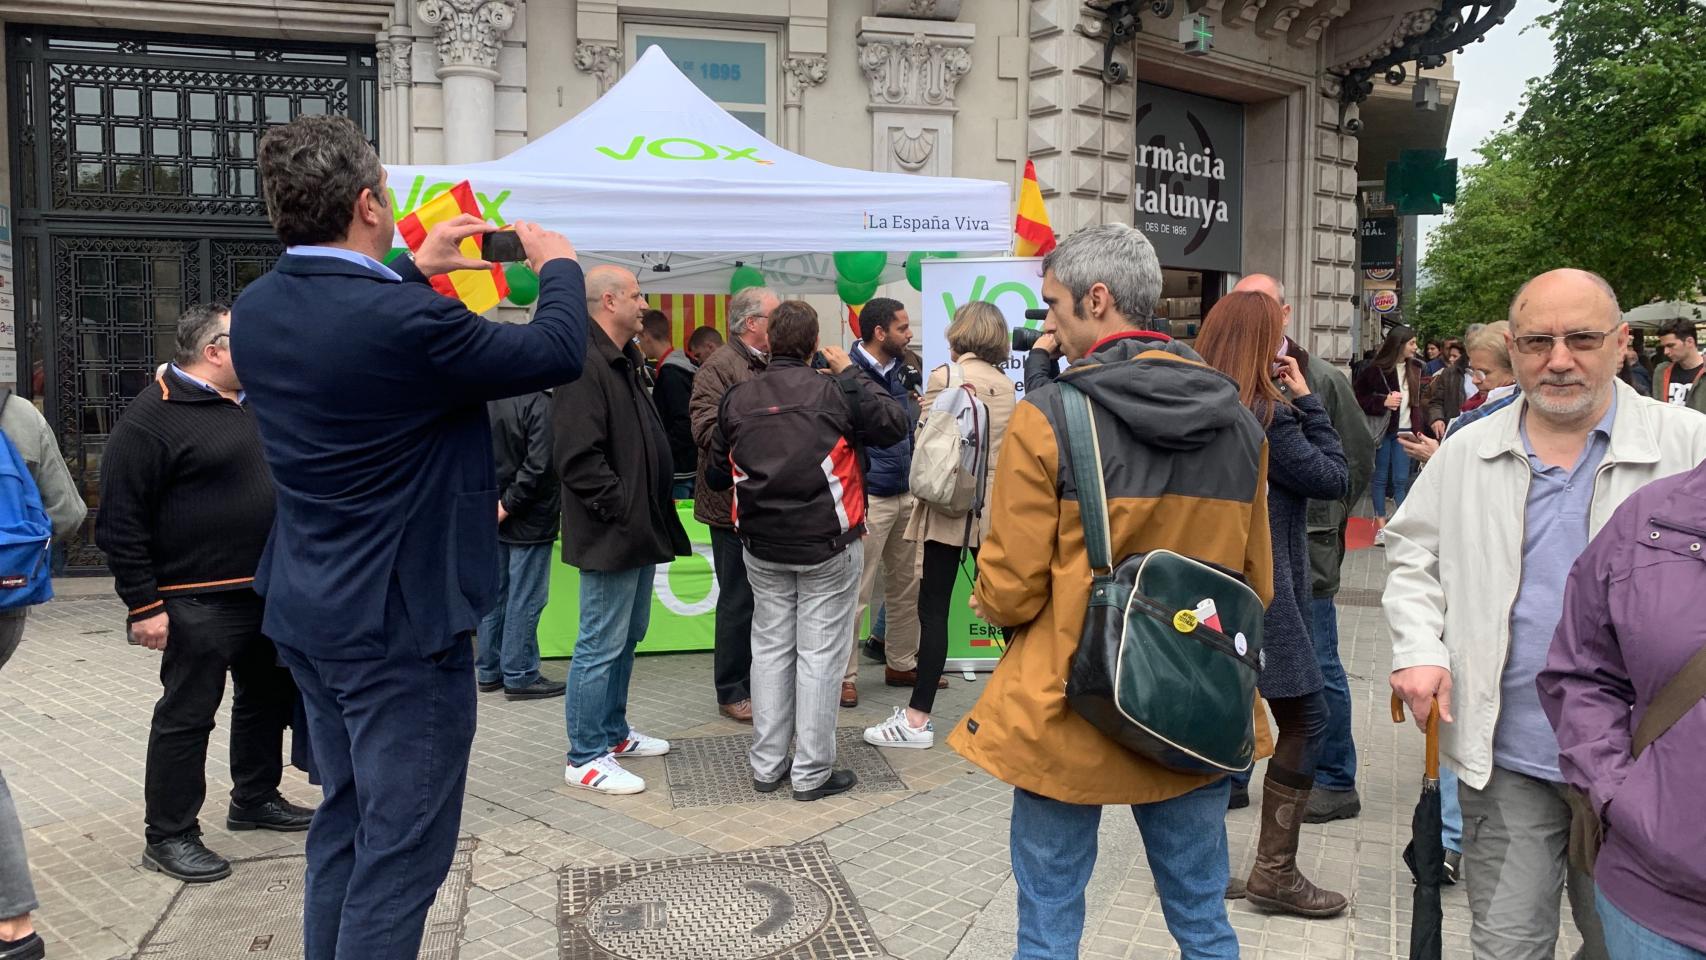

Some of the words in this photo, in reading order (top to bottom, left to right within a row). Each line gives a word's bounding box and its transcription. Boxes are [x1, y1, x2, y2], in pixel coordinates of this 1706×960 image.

[701, 63, 742, 81] 1895
[595, 135, 760, 161] VOX
[1135, 142, 1226, 180] rmàcia
[1135, 183, 1229, 229] talunya
[868, 214, 888, 229] La
[892, 215, 950, 232] España
[955, 216, 990, 231] Viva
[1145, 222, 1159, 232] DES
[1160, 224, 1170, 234] DE
[1172, 225, 1187, 236] 1895
[942, 275, 1041, 342] VO
[1375, 299, 1395, 307] KING
